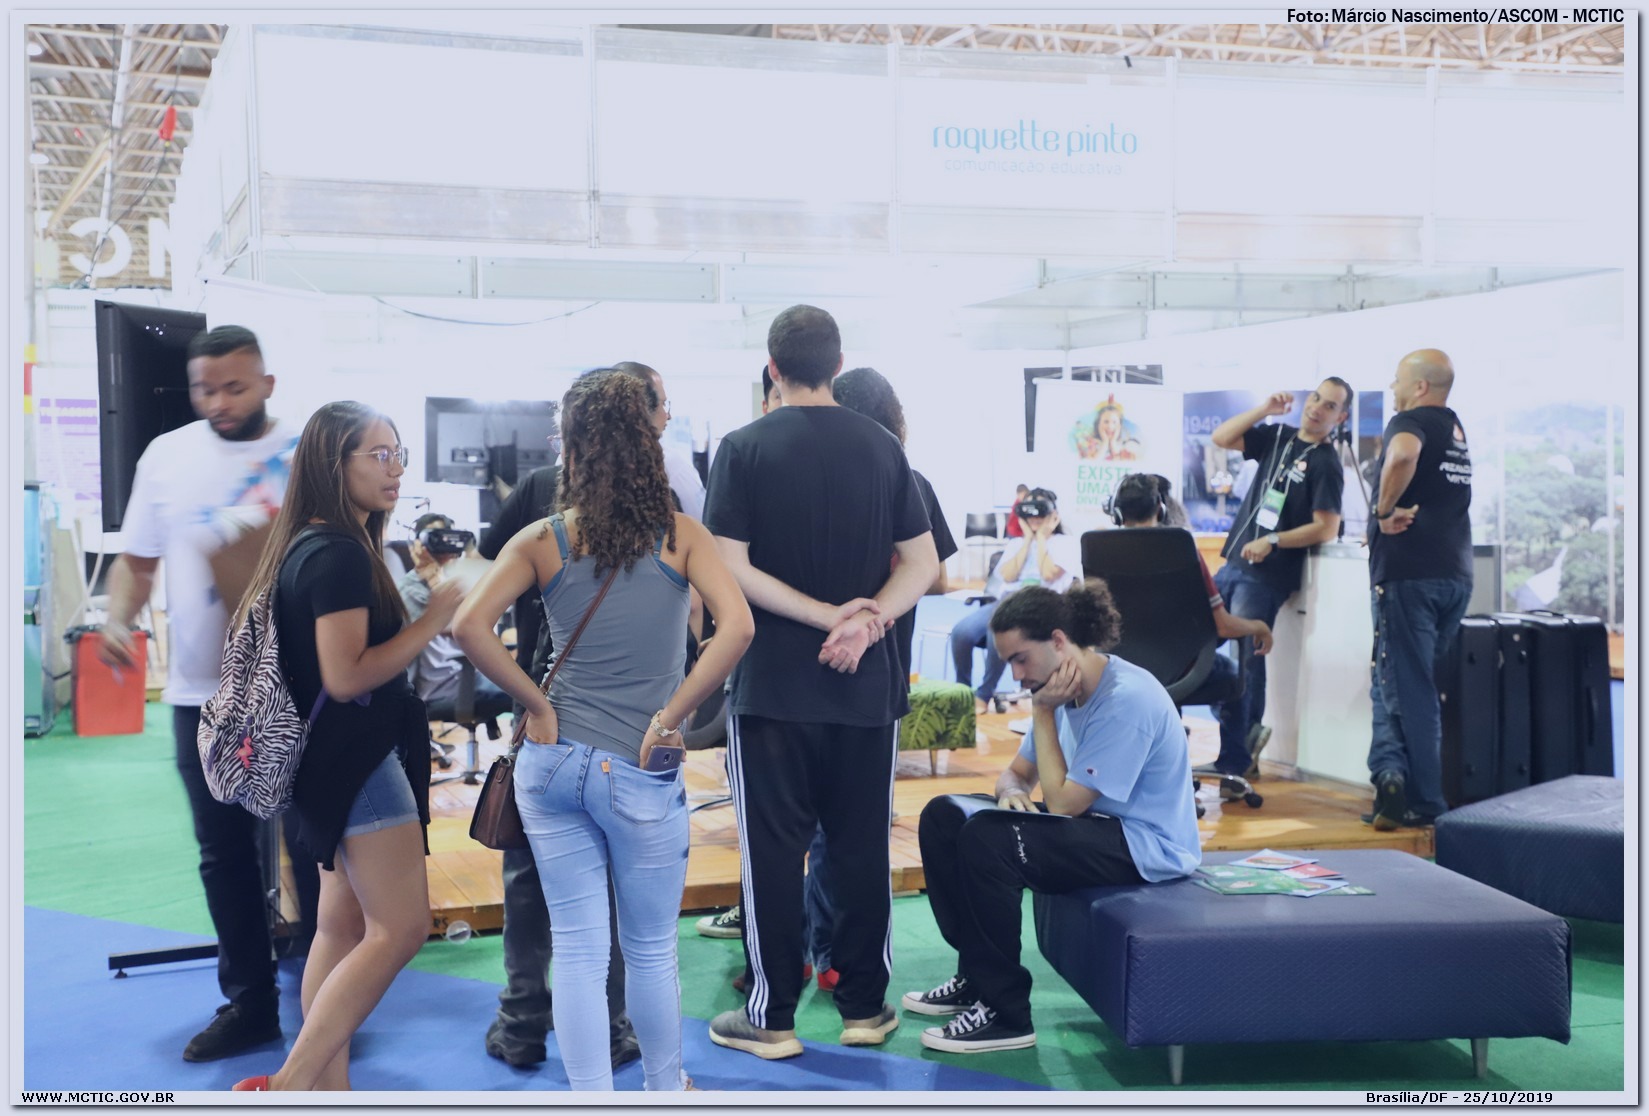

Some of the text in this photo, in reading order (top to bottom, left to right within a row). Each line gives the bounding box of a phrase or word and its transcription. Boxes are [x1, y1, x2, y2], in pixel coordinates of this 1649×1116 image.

[933, 119, 1138, 157] roquette pinto
[1050, 162, 1122, 175] educativa
[1077, 481, 1110, 495] UMA
